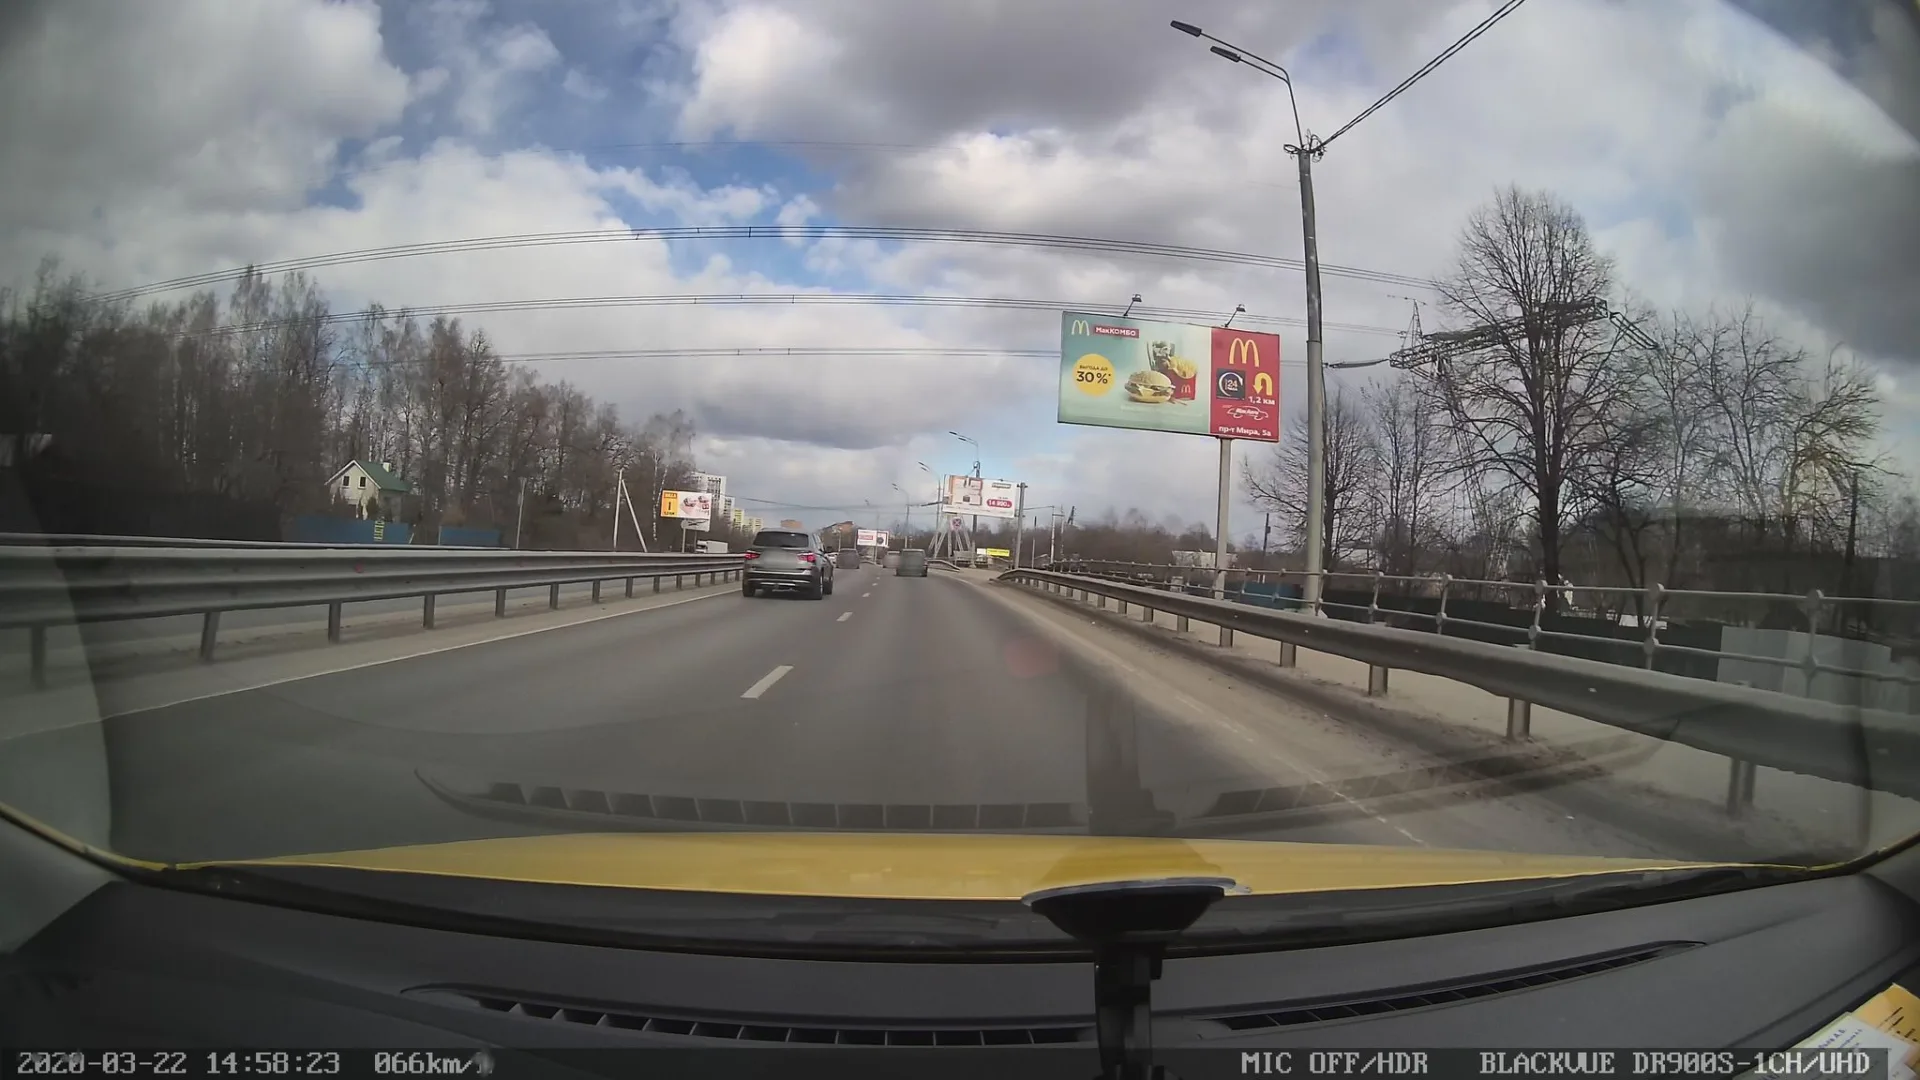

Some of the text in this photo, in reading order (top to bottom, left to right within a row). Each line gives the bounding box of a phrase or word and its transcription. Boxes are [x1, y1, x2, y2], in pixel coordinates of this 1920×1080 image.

[1095, 327, 1136, 337] МакКОМБО
[1248, 396, 1262, 404] 1,2
[1218, 426, 1235, 434] пр-т
